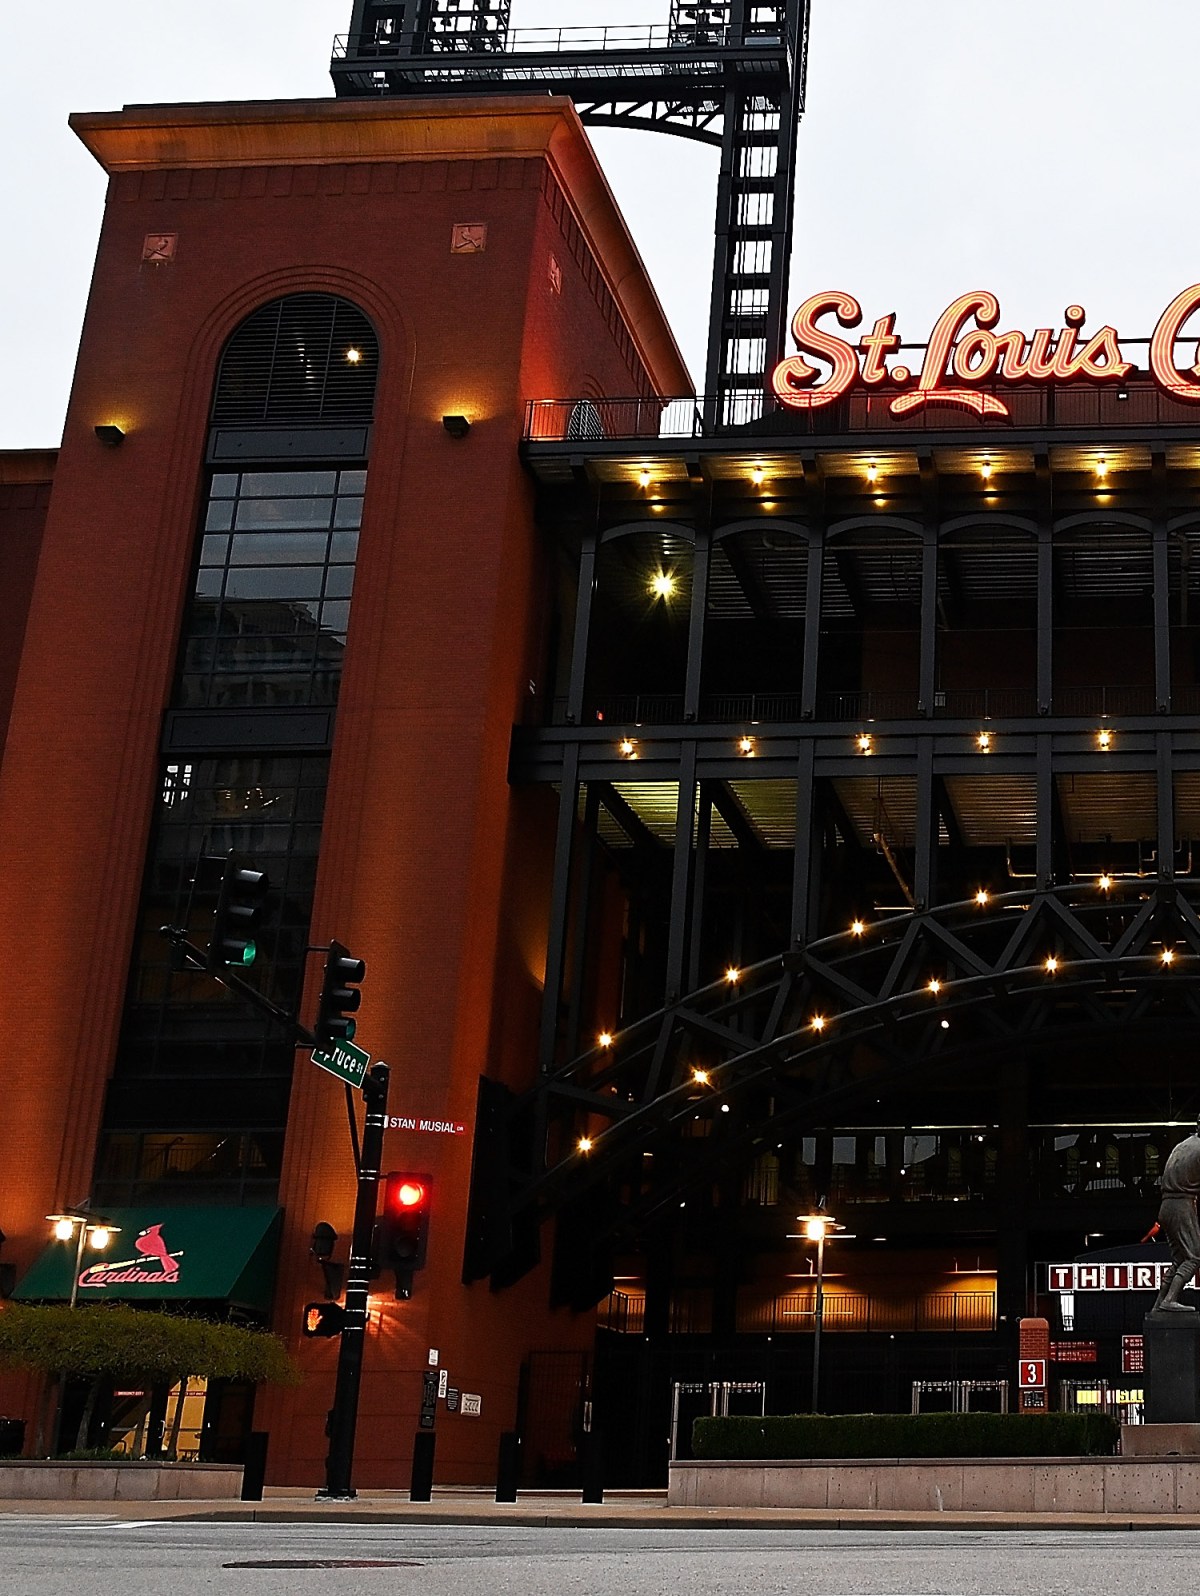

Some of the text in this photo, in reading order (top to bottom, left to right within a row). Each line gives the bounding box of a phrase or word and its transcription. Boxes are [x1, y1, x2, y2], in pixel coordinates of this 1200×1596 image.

[771, 290, 911, 410] St.
[889, 289, 1135, 420] Louis
[318, 1046, 357, 1073] ruce
[390, 1117, 416, 1130] STAN
[419, 1119, 456, 1134] MUSIAL
[78, 1262, 179, 1288] Cardinals
[1055, 1267, 1169, 1288] THIR
[1027, 1363, 1037, 1384] 3
